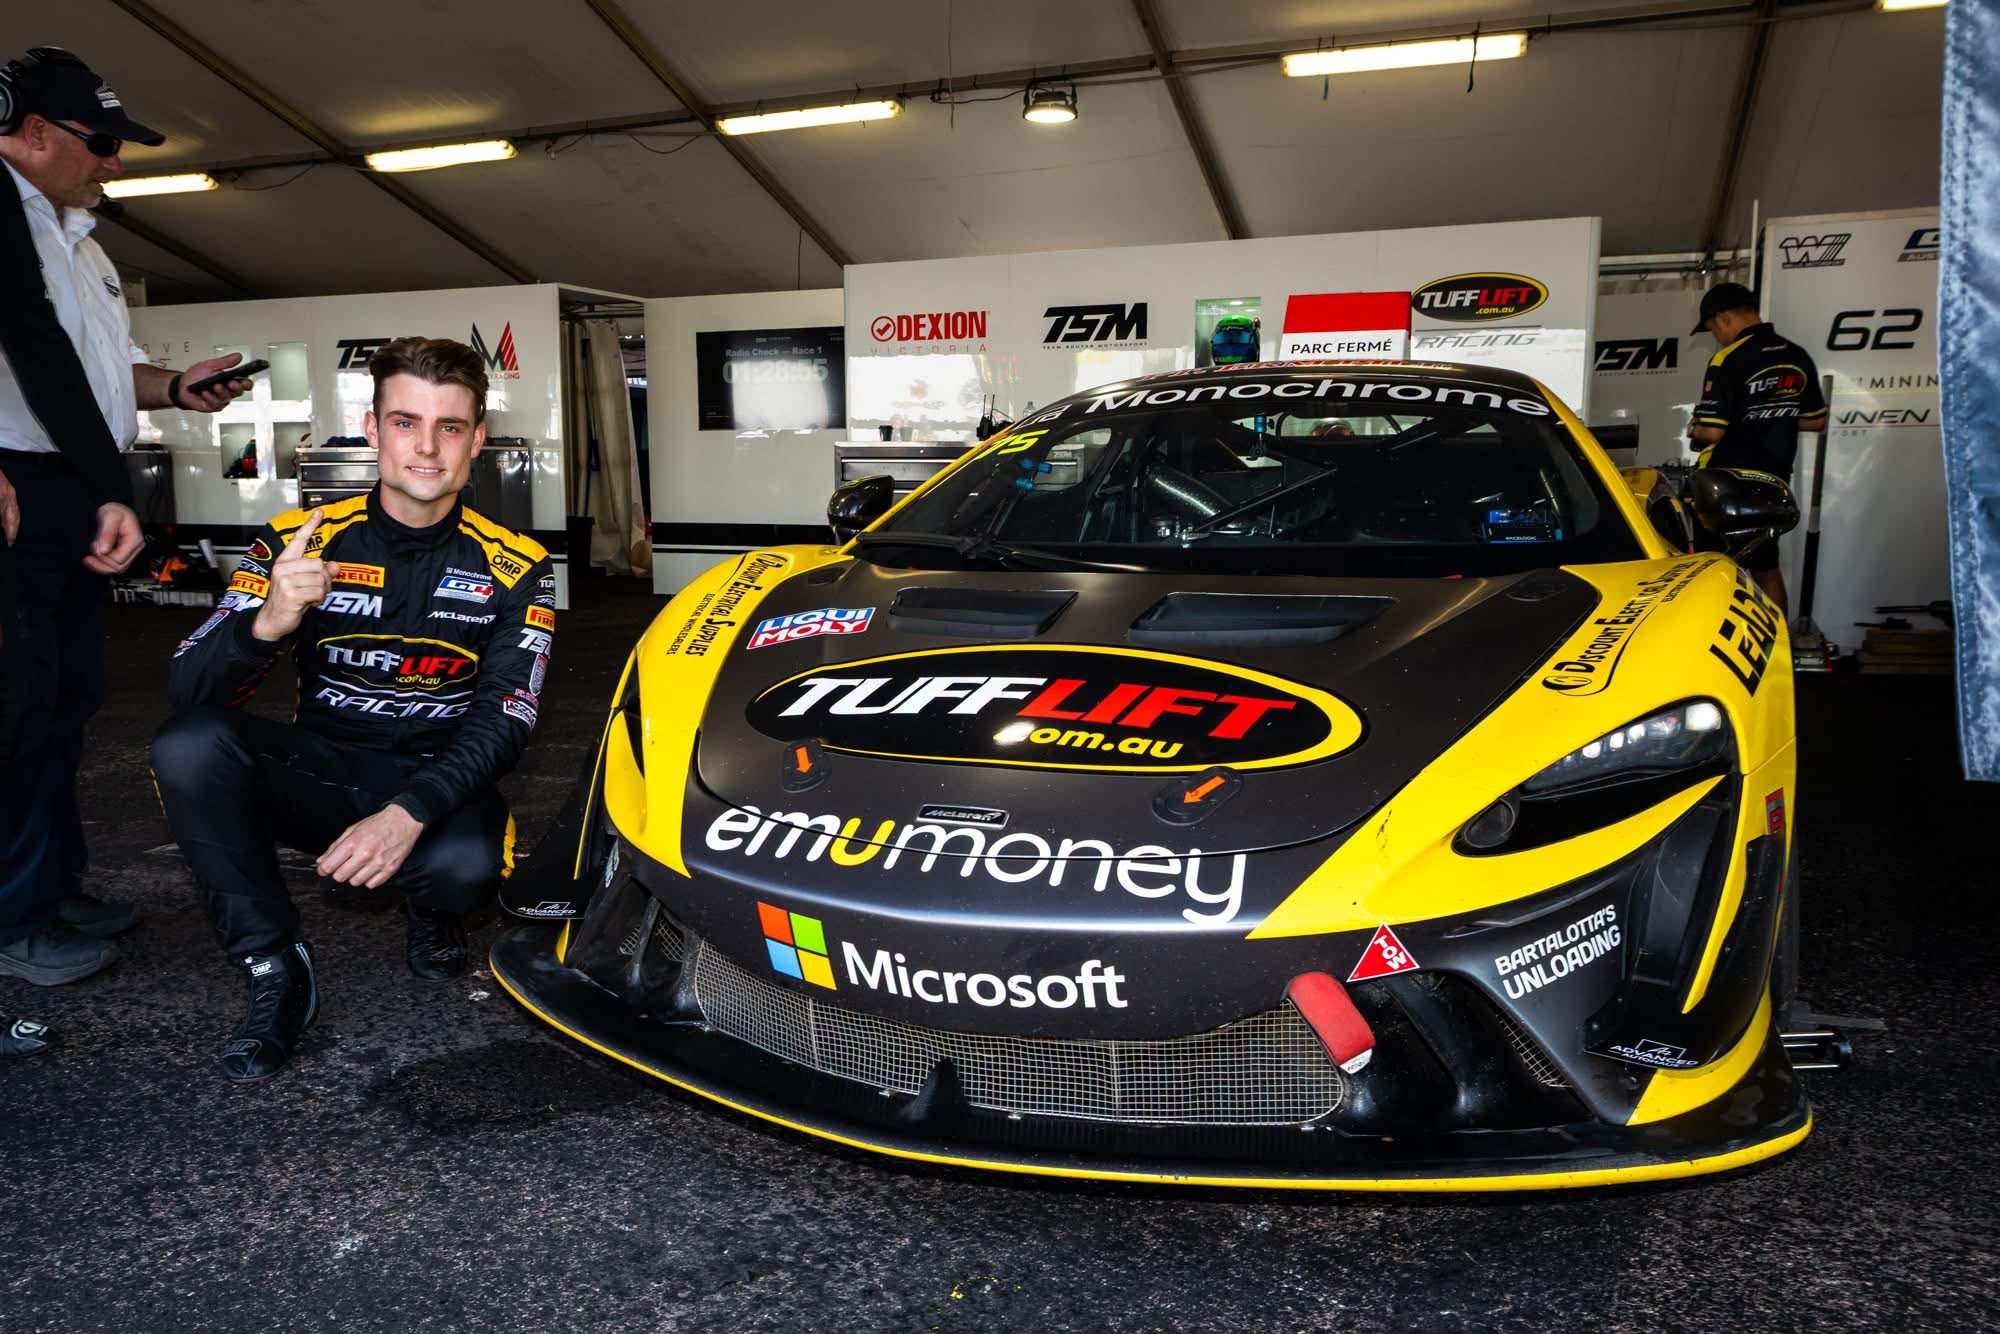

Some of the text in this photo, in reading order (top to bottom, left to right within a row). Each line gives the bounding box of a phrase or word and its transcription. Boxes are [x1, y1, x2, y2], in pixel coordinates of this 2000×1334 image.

[1420, 287, 1535, 309] TUFFLIFT
[1475, 306, 1515, 315] .com.au
[897, 311, 986, 341] DEXION
[1042, 302, 1148, 343] TSM
[1826, 309, 1923, 351] 62
[725, 349, 750, 357] Radio
[752, 348, 780, 356] Check
[792, 346, 815, 355] Race
[817, 346, 823, 354] 1
[871, 343, 987, 355] VICTORIA
[1291, 338, 1392, 355] PARC FERMÉ
[1413, 333, 1542, 349] RACING
[336, 338, 391, 369] TS
[1869, 375, 1938, 388] MININ
[1085, 378, 1550, 416] Monochrome
[973, 429, 1050, 461] 75
[453, 568, 493, 581] Monochrome
[493, 554, 521, 575] OMP
[338, 571, 379, 584] RELLI
[446, 579, 494, 597] GT4
[217, 591, 266, 612] SM
[427, 610, 492, 624] McLaren
[763, 609, 868, 632] LIQUI
[755, 619, 860, 646] MOLY
[324, 644, 471, 675] TUFFLIFT
[1552, 626, 1629, 673] DISCOUNT
[315, 687, 472, 719] RACING
[778, 675, 1298, 741] TUFFLIFT
[924, 809, 1000, 821] McLaren
[704, 803, 1247, 926] emumoney
[517, 906, 577, 915] ADVANCED
[1494, 904, 1617, 976] BARTALOTTA'S
[1374, 934, 1408, 971] TOW
[1502, 924, 1622, 1000] UNLOADING
[251, 963, 272, 975] OMP
[841, 940, 1129, 1010] Microsoft
[1610, 1045, 1699, 1065] ADVANCED
[1621, 1053, 1680, 1067] AUTOHAUS
